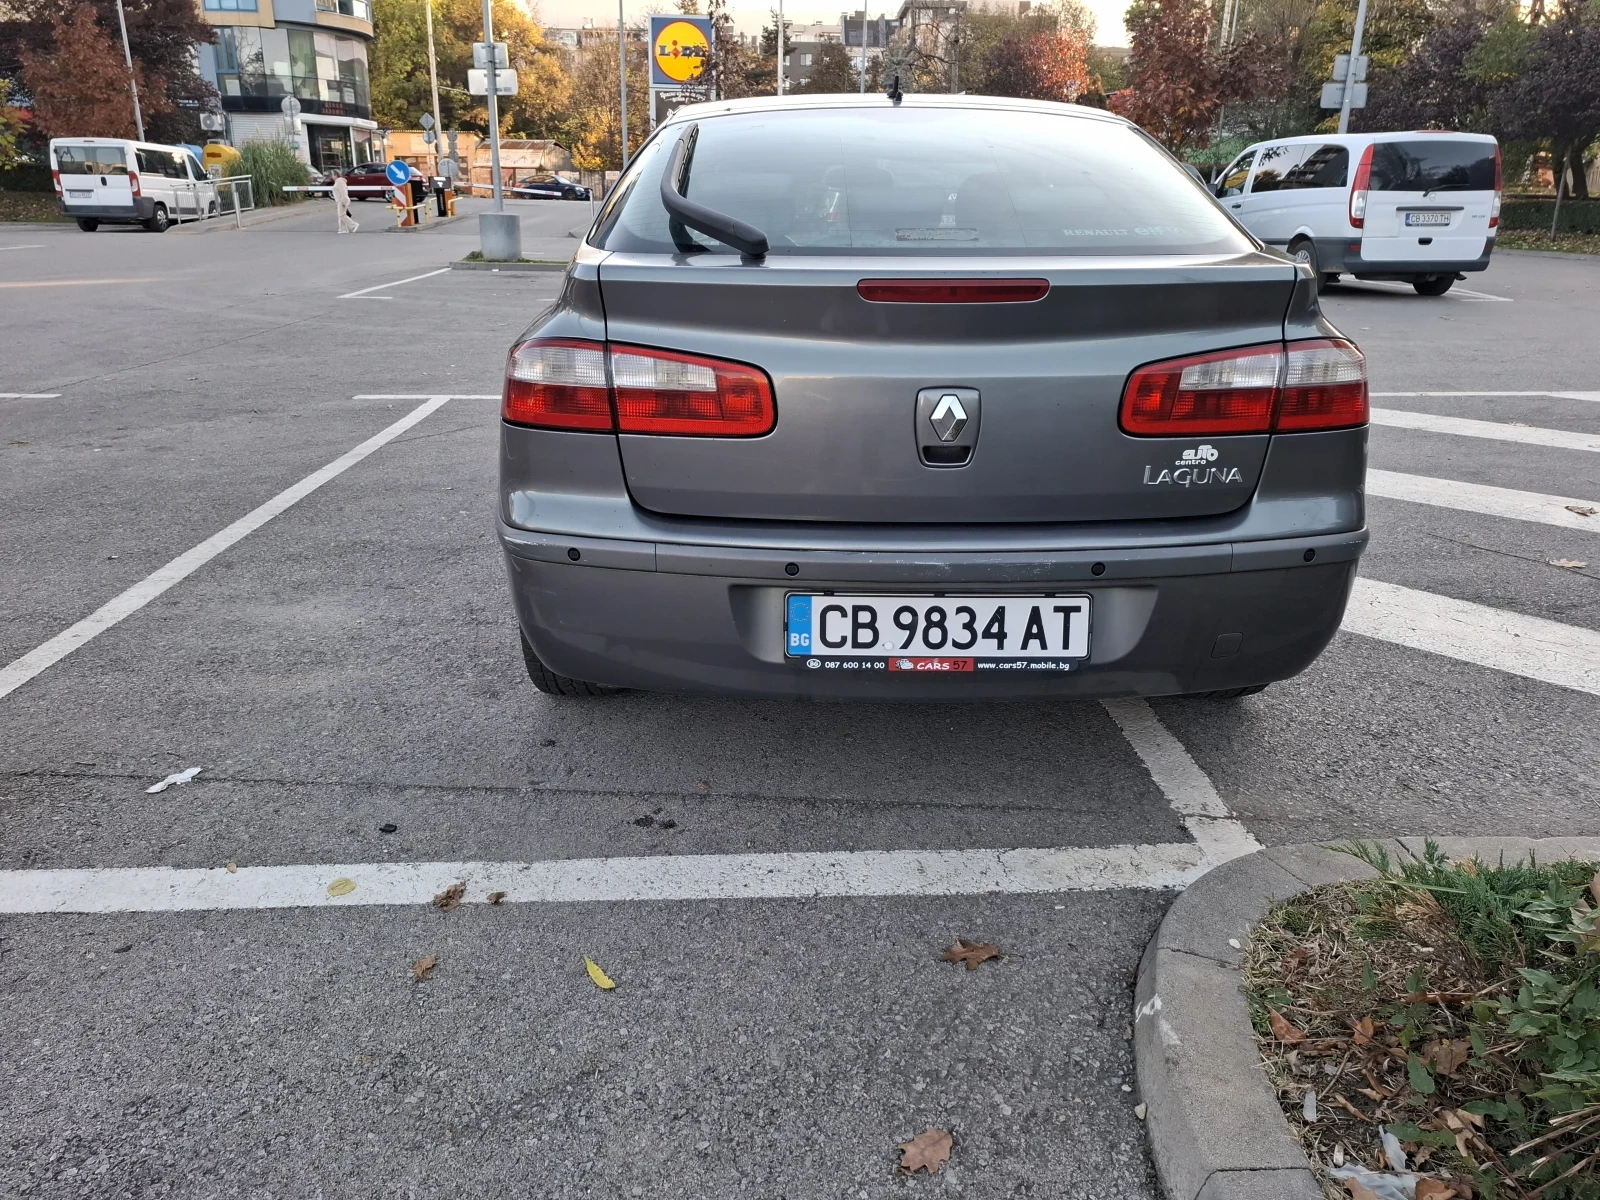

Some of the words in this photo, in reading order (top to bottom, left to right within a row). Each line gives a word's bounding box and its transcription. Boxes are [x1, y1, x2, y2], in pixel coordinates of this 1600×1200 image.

[1411, 214, 1420, 223] CB
[1421, 214, 1438, 223] 3370
[1440, 214, 1449, 223] TH
[1062, 228, 1129, 236] RENAULT
[819, 604, 880, 650] CB
[893, 605, 1008, 651] 9834
[1020, 605, 1082, 651] AT
[790, 633, 810, 647] BG
[824, 661, 840, 669] 087
[843, 661, 859, 669] 600
[861, 661, 872, 669] 14
[873, 661, 885, 669] 00
[916, 661, 950, 670] CARS
[952, 660, 968, 670] 57
[977, 661, 1070, 671] www.cars57.mobile.bg
